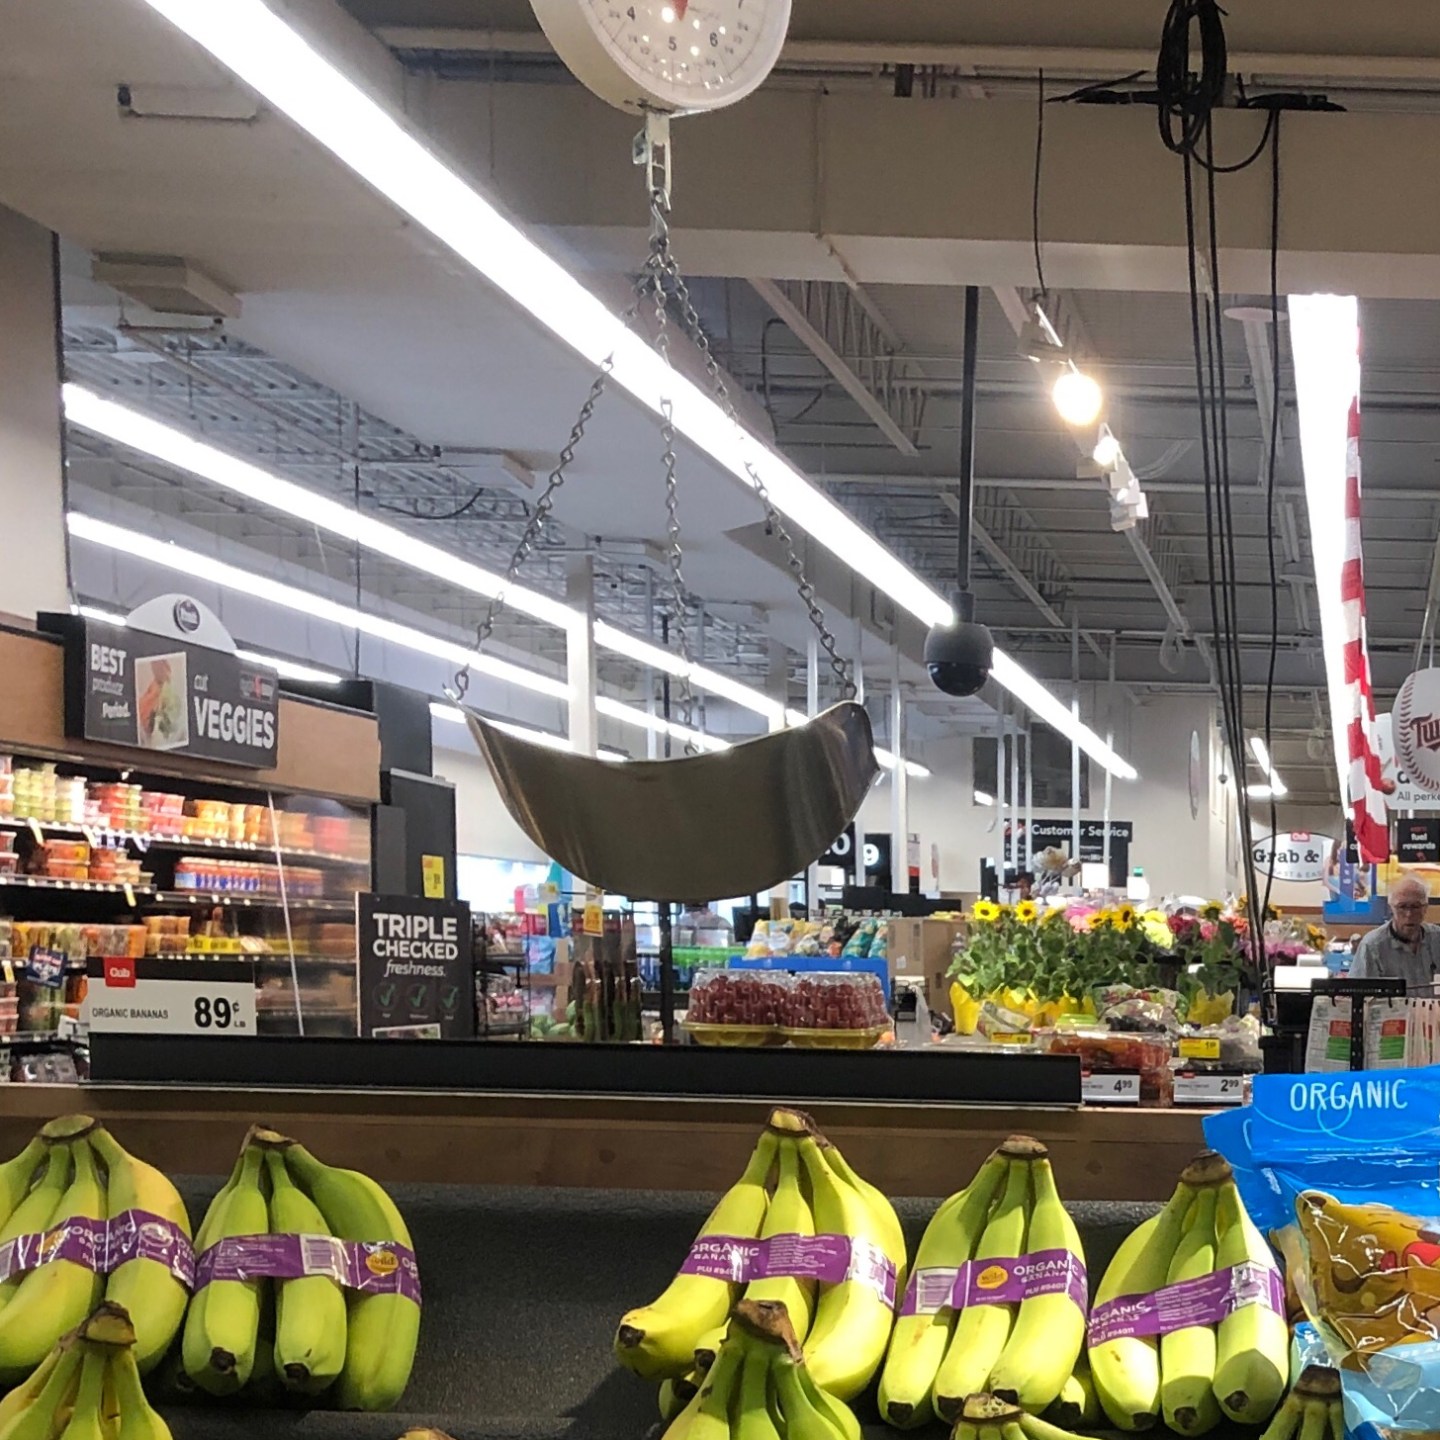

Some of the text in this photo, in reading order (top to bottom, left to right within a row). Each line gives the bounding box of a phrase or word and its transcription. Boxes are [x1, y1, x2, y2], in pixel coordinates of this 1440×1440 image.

[668, 37, 677, 51] 5
[709, 32, 719, 47] 6
[91, 643, 127, 676] BEST
[92, 675, 124, 697] produce
[102, 702, 131, 720] Period.
[193, 696, 275, 749] VEGGIES
[1397, 791, 1411, 802] All
[1031, 824, 1086, 836] Customr
[1402, 842, 1436, 851] rewards
[1253, 849, 1320, 864] Grab &
[373, 913, 458, 941] TRIPLE
[372, 939, 459, 961] CHECKED
[384, 958, 447, 978] freshness.
[92, 1007, 169, 1020] ORGANIC BANANAS
[1290, 1078, 1408, 1111] ORGANIC
